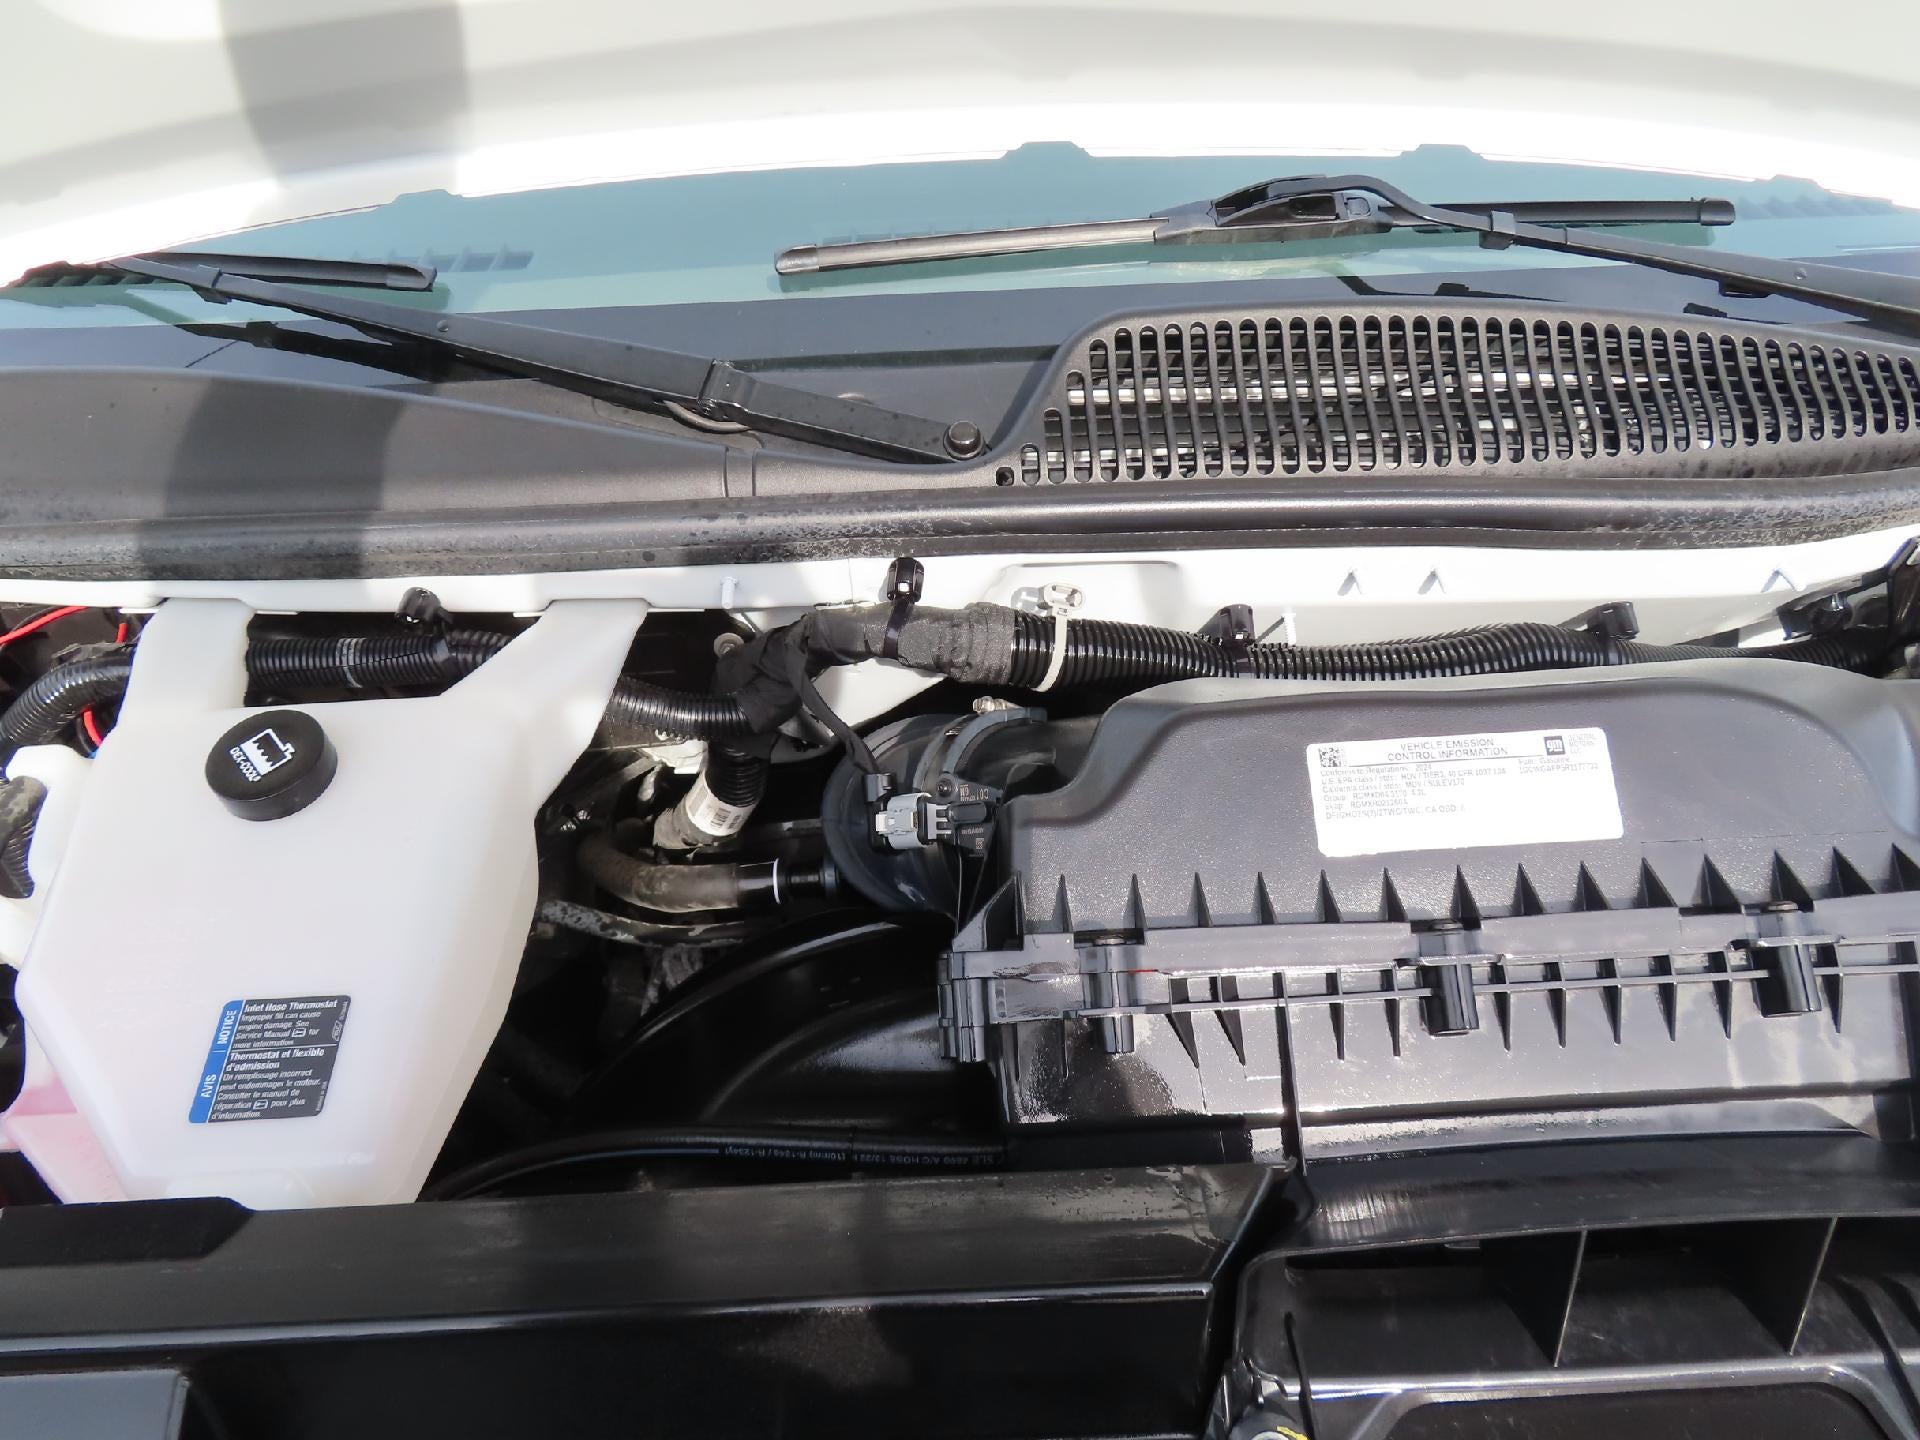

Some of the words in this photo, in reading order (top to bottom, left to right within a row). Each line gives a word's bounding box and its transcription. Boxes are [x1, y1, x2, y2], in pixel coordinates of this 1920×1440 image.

[1400, 740, 1443, 752] VEHICLE
[1445, 738, 1496, 749] EMISSION
[1387, 751, 1438, 762] CONTROL
[1439, 746, 1509, 759] INFORMATION
[245, 1003, 265, 1013] Inlet
[265, 1002, 288, 1012] Hose
[289, 1000, 338, 1010] Thermostat
[241, 1013, 274, 1022] Improper
[216, 1010, 238, 1045] NOTICE
[235, 1032, 263, 1040] Service
[263, 1029, 292, 1038] Manual
[229, 1050, 280, 1060] Thermostat
[281, 1049, 292, 1058] et
[292, 1048, 325, 1057] flexible
[226, 1060, 280, 1071] d'admission
[234, 1071, 279, 1081] remplissage
[279, 1069, 313, 1078] incorrect
[200, 1074, 217, 1098] AVIS
[218, 1083, 237, 1092] peut
[237, 1080, 284, 1089] endommager
[217, 1091, 252, 1100] Consulter
[270, 1100, 288, 1109] pour
[288, 1098, 306, 1108] plus
[889, 1154, 919, 1165] HOSE
